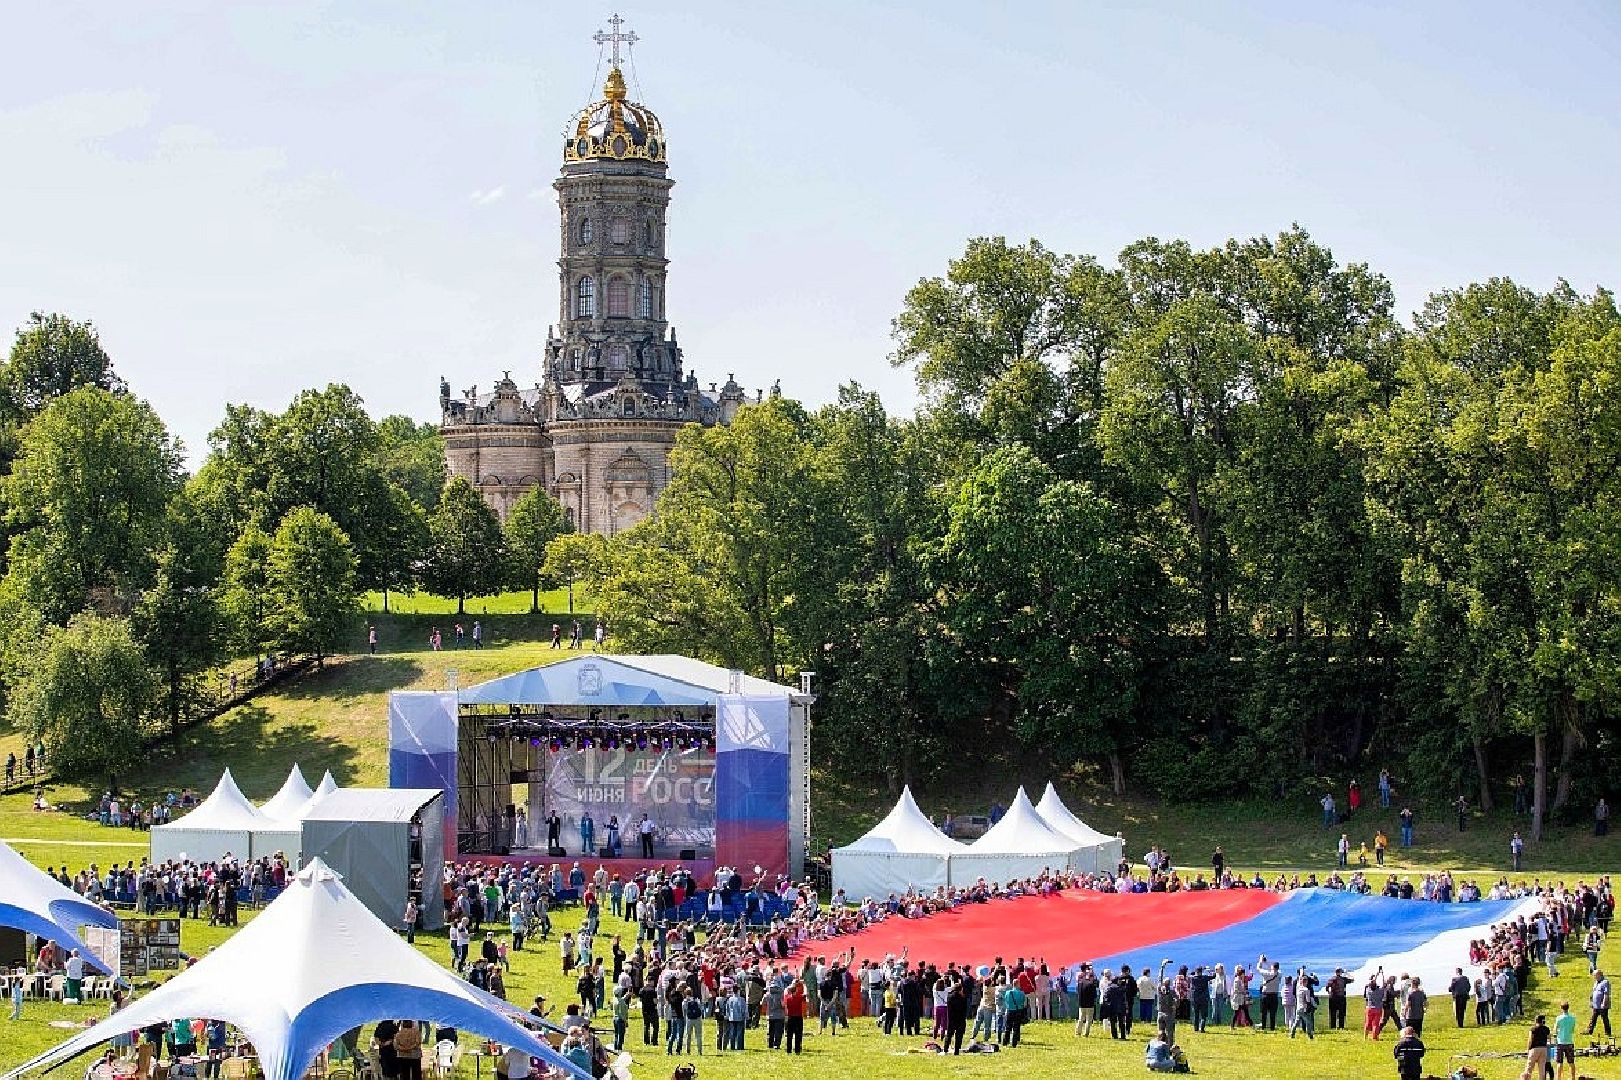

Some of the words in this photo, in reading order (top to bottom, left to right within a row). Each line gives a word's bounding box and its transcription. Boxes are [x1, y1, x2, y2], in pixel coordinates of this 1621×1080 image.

[584, 747, 625, 785] 12
[633, 759, 678, 774] ДЕНЬ
[577, 787, 625, 803] ИЮНЯ
